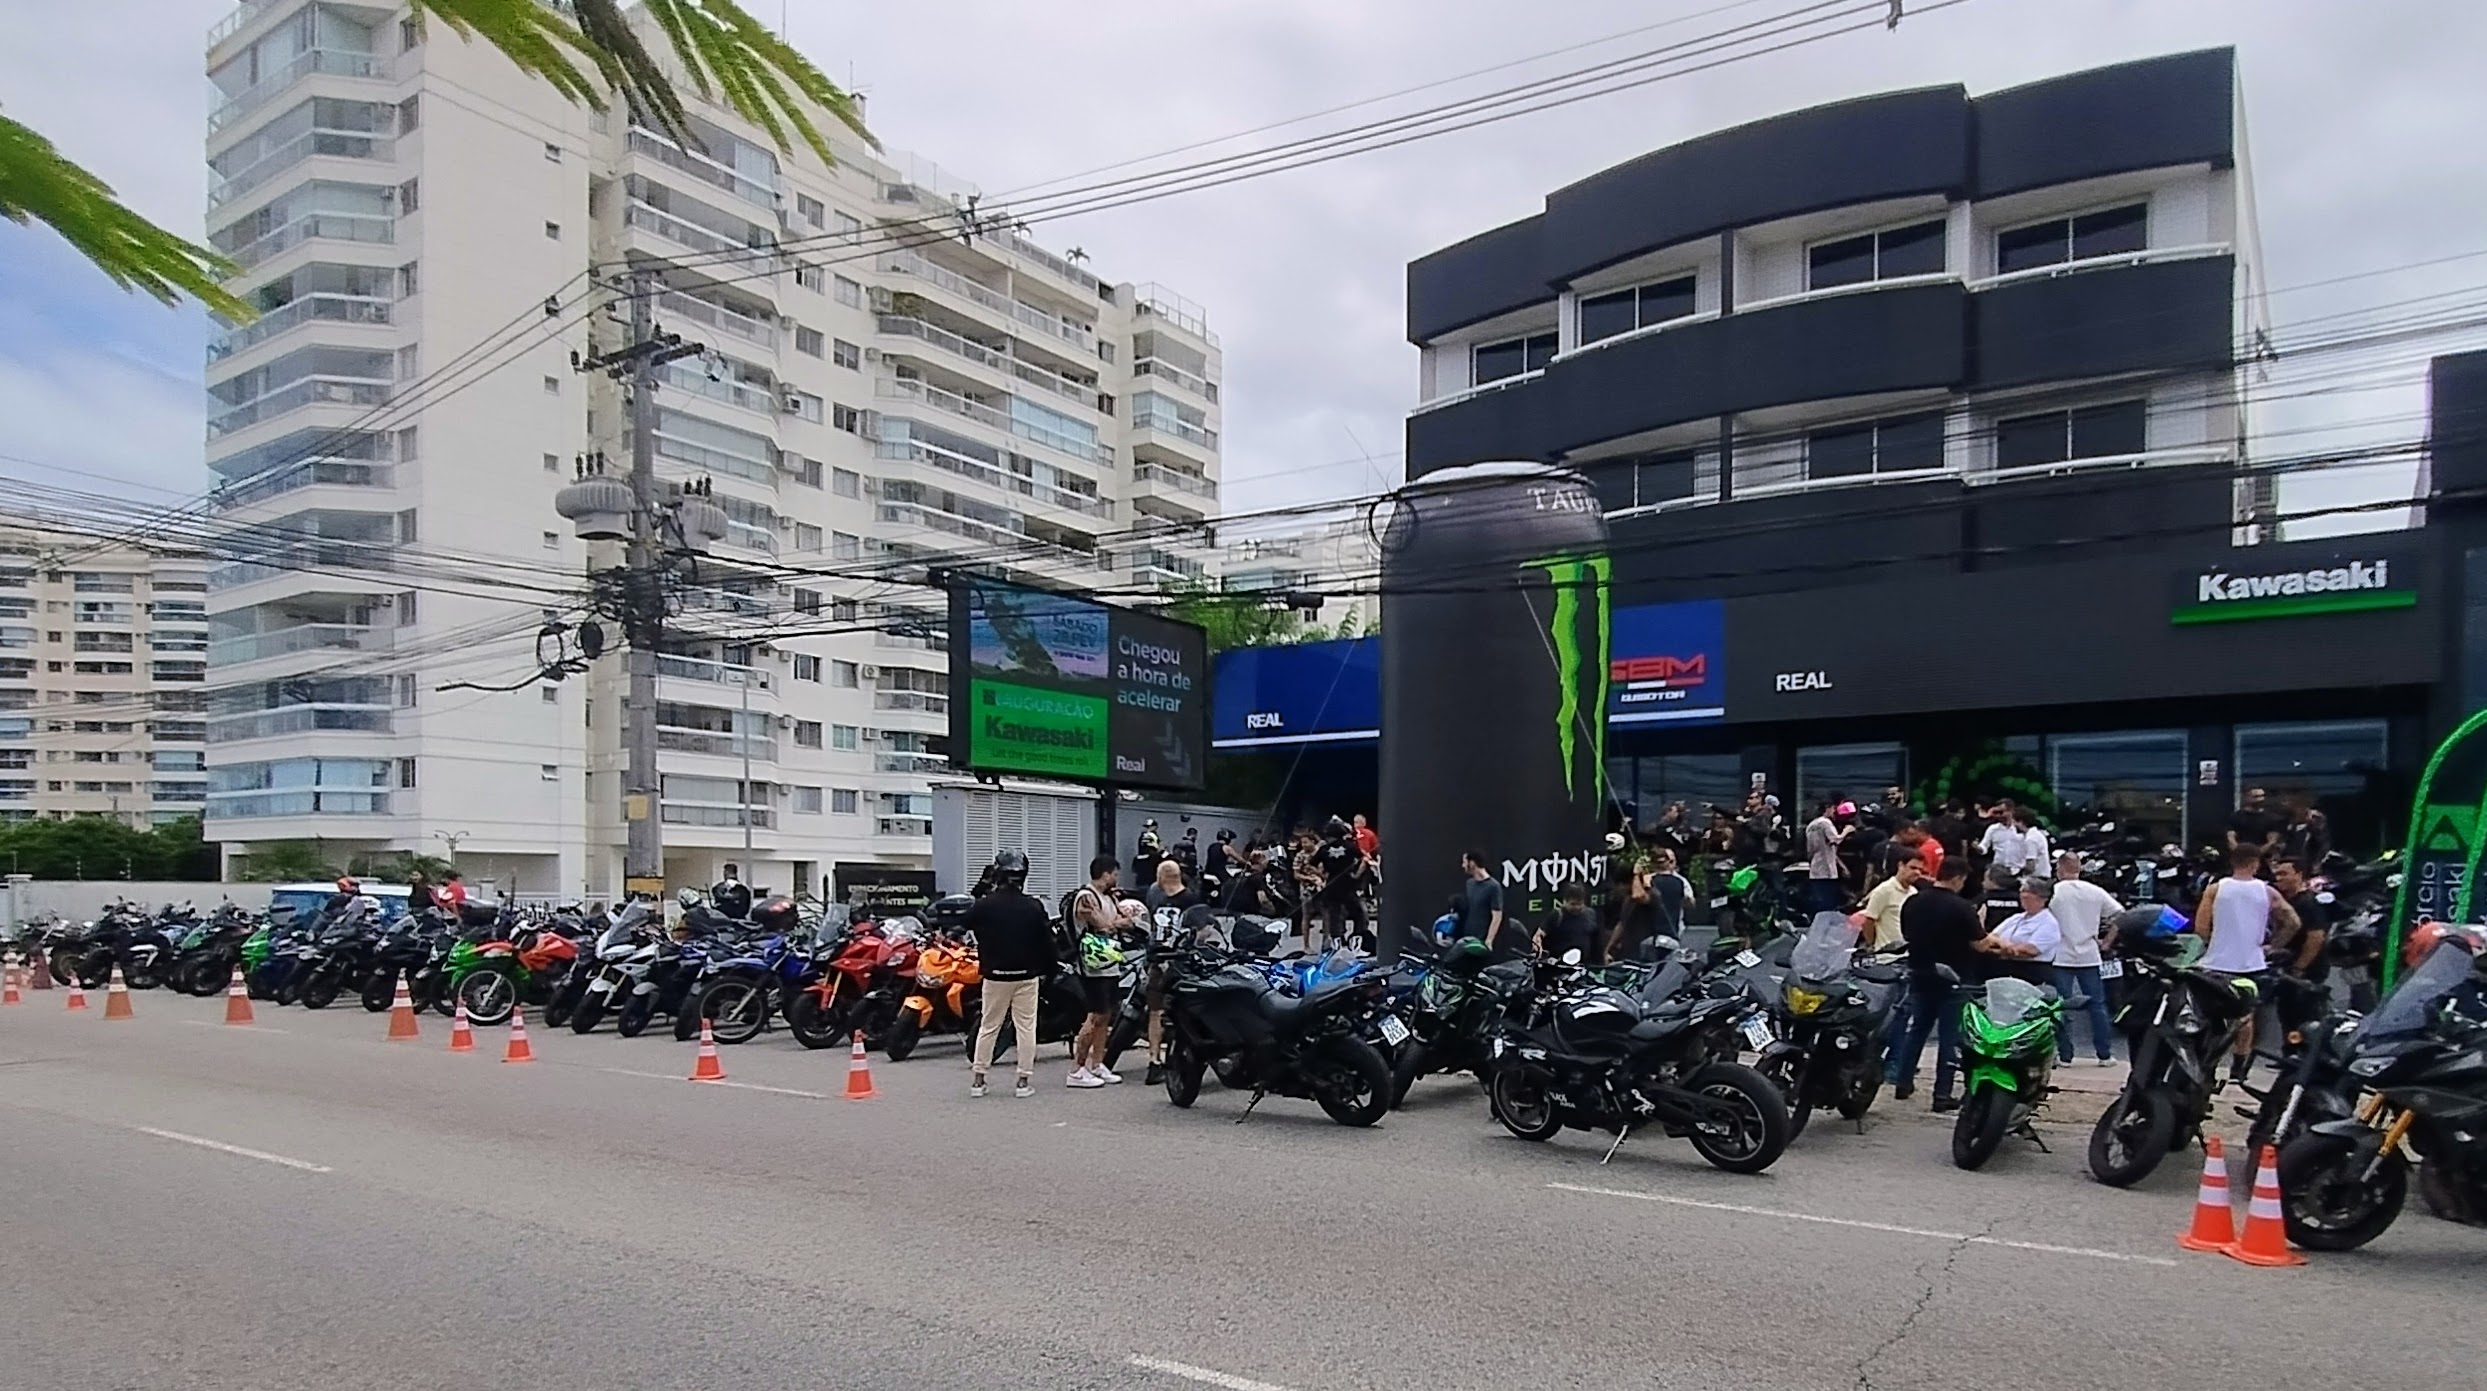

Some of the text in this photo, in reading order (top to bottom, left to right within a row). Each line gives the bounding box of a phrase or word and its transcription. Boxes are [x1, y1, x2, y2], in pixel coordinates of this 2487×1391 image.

[2198, 558, 2388, 602] Kawasaki
[1118, 635, 1181, 665] Chegou
[1117, 661, 1192, 691] a hora de
[1776, 670, 1832, 691] REAL
[1117, 689, 1182, 713] acelerar
[984, 714, 1095, 751] Kawasaki
[1247, 712, 1285, 729] REAL
[1116, 755, 1146, 772] Real
